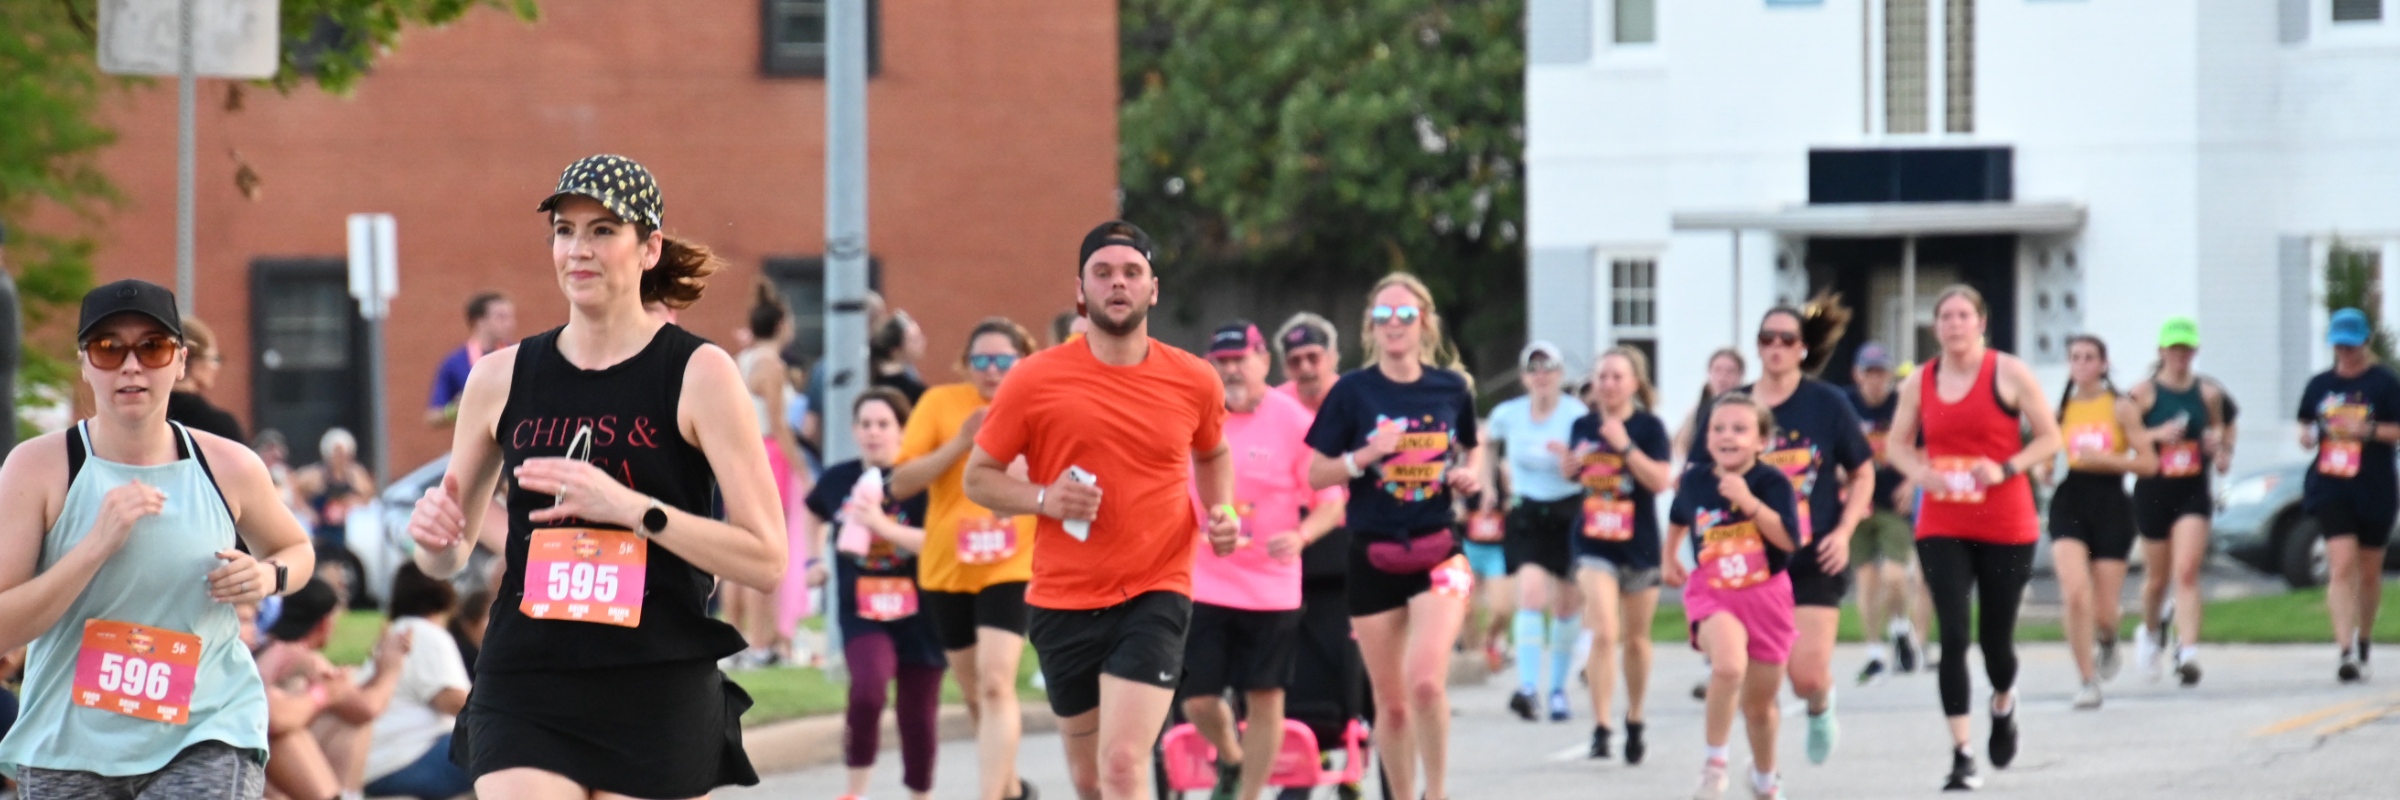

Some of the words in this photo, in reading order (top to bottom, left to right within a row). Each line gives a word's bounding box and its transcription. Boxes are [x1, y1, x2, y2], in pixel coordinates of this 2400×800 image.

[627, 415, 659, 448] &
[1396, 465, 1434, 477] MAYO
[547, 561, 619, 603] 595
[1718, 553, 1748, 579] 53
[98, 651, 172, 701] 596
